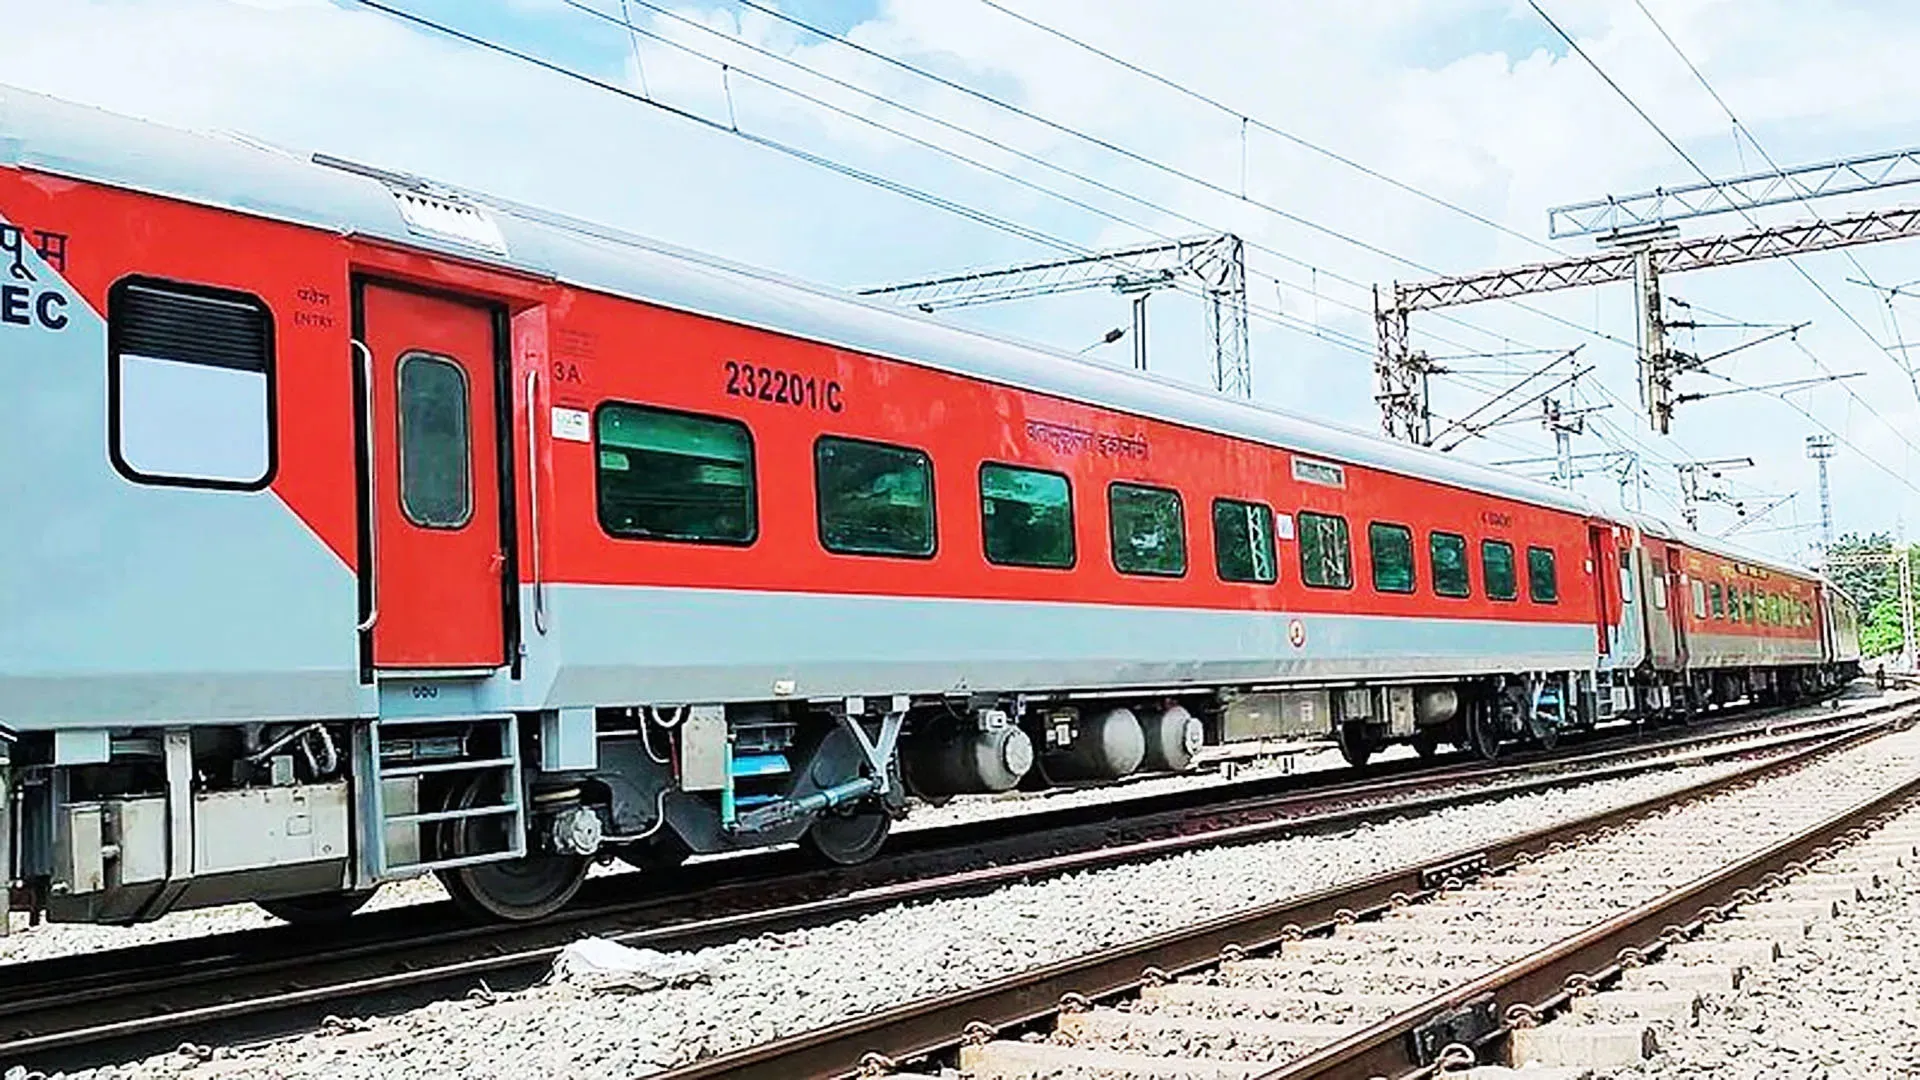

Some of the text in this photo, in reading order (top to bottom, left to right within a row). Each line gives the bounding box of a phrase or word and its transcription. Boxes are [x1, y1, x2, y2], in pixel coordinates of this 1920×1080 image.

[2, 284, 69, 330] EC
[294, 310, 334, 328] ENTRY
[554, 360, 582, 385] 3A
[724, 360, 844, 413] 232201/C
